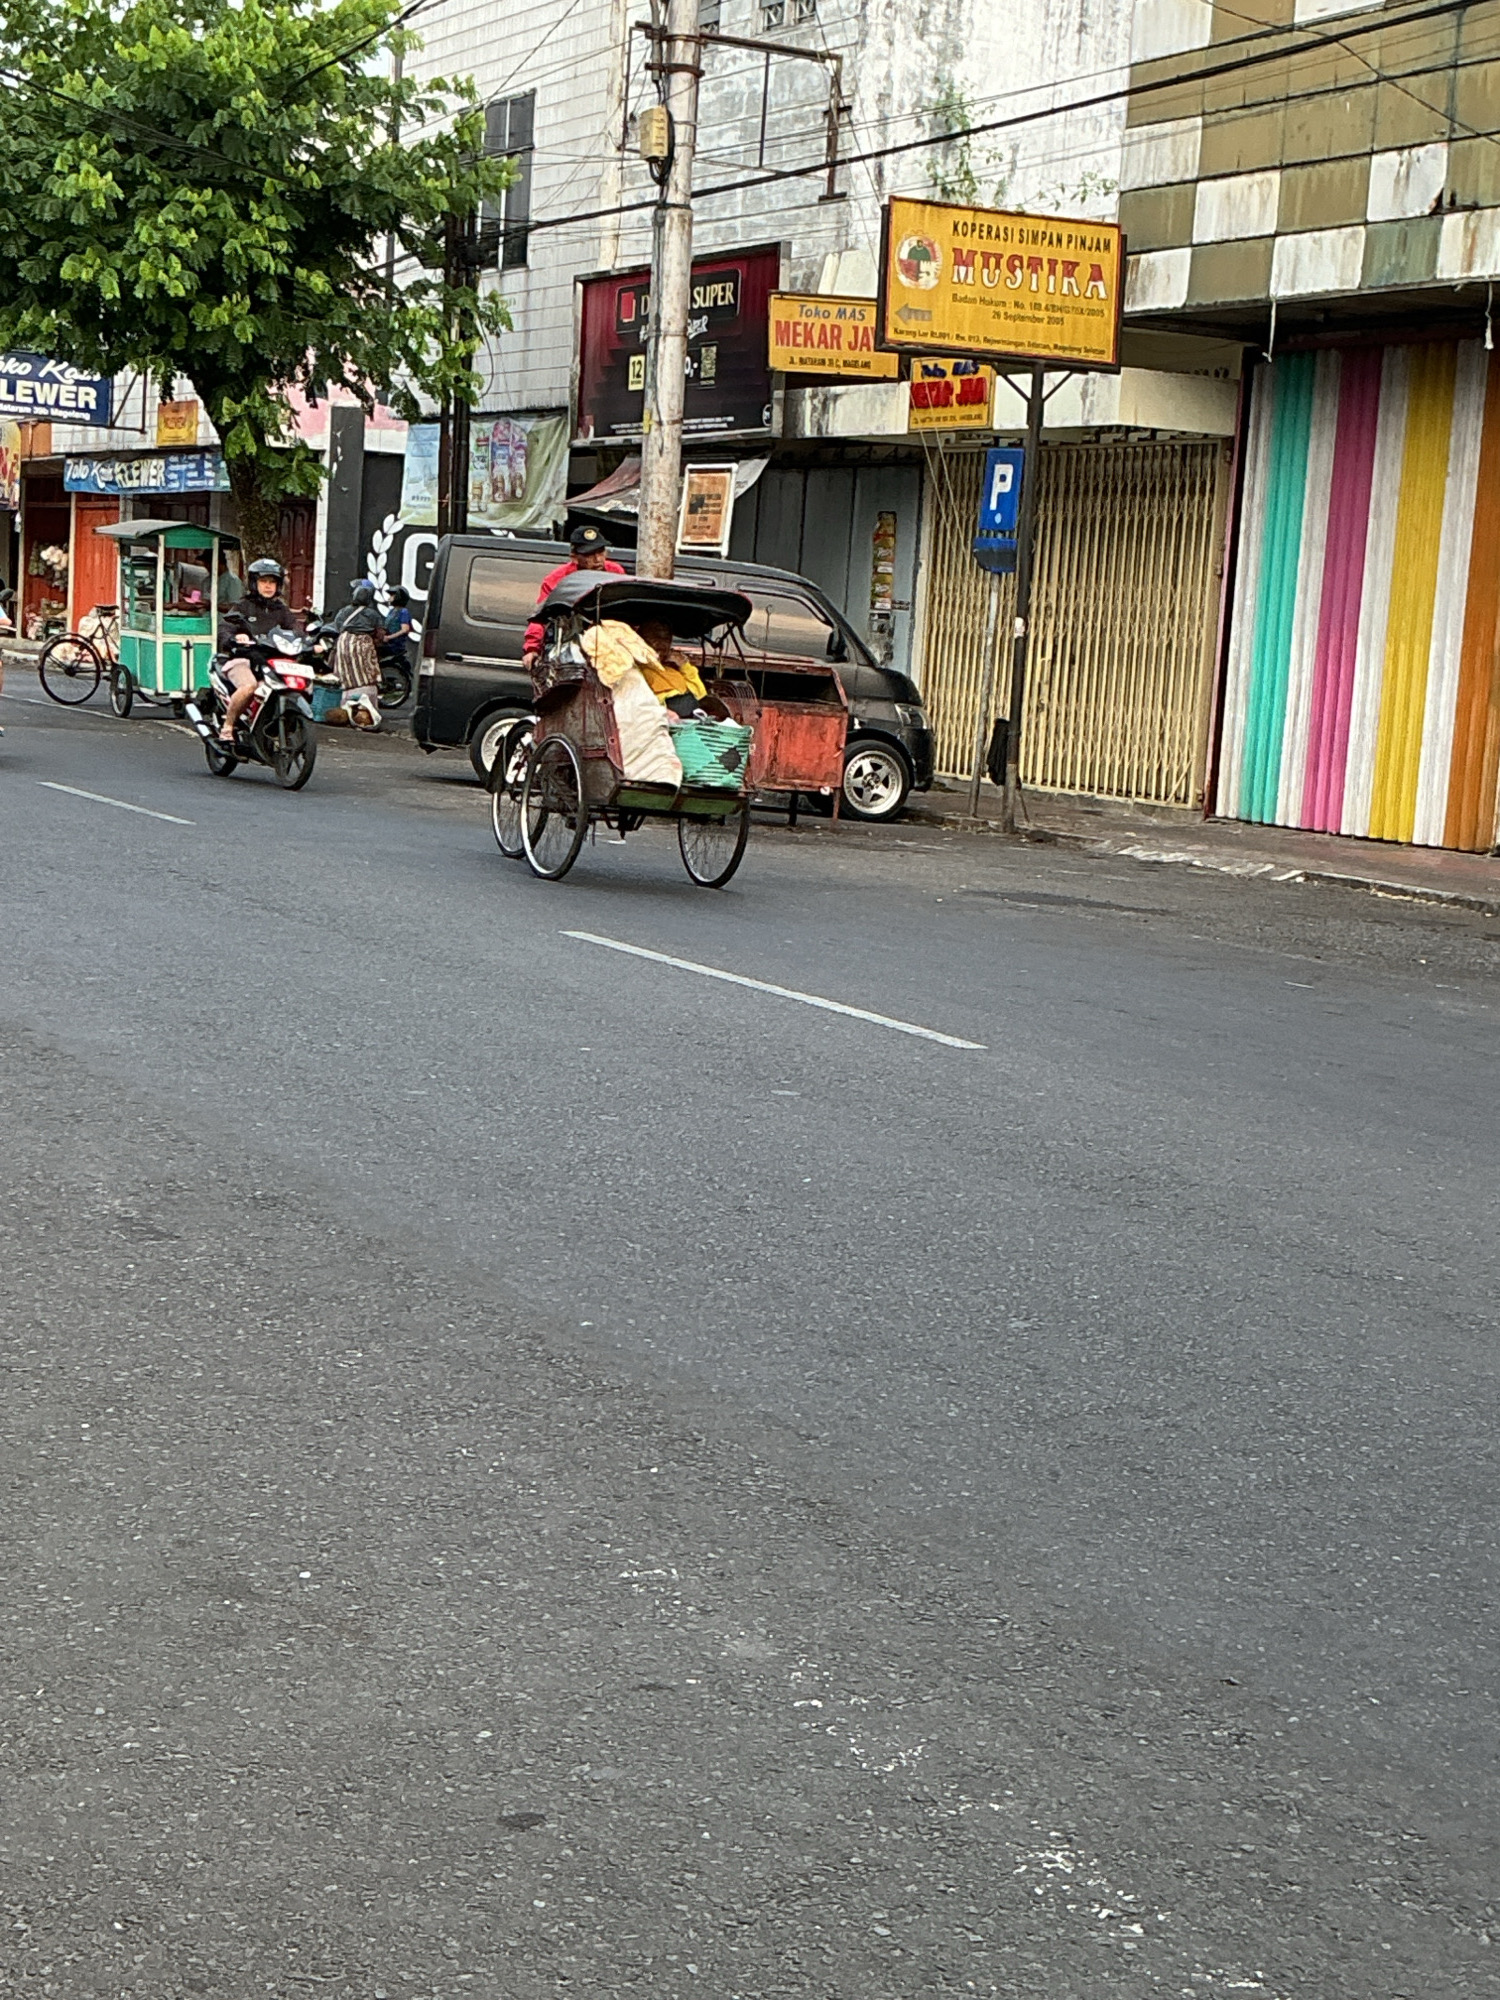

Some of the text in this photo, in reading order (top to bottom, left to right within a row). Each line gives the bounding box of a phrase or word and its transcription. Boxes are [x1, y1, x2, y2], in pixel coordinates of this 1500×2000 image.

[952, 219, 1111, 254] KOPERASI SIMPAN PINJAM
[951, 247, 1109, 301] MUSTIKA
[692, 282, 735, 310] SUPER
[799, 304, 867, 322] Toko MAS
[1003, 311, 1045, 324] September
[775, 320, 842, 351] MEKAR
[0, 356, 33, 376] oko
[631, 360, 643, 379] 12
[113, 459, 166, 488] KLEWER
[989, 463, 1014, 511] P
